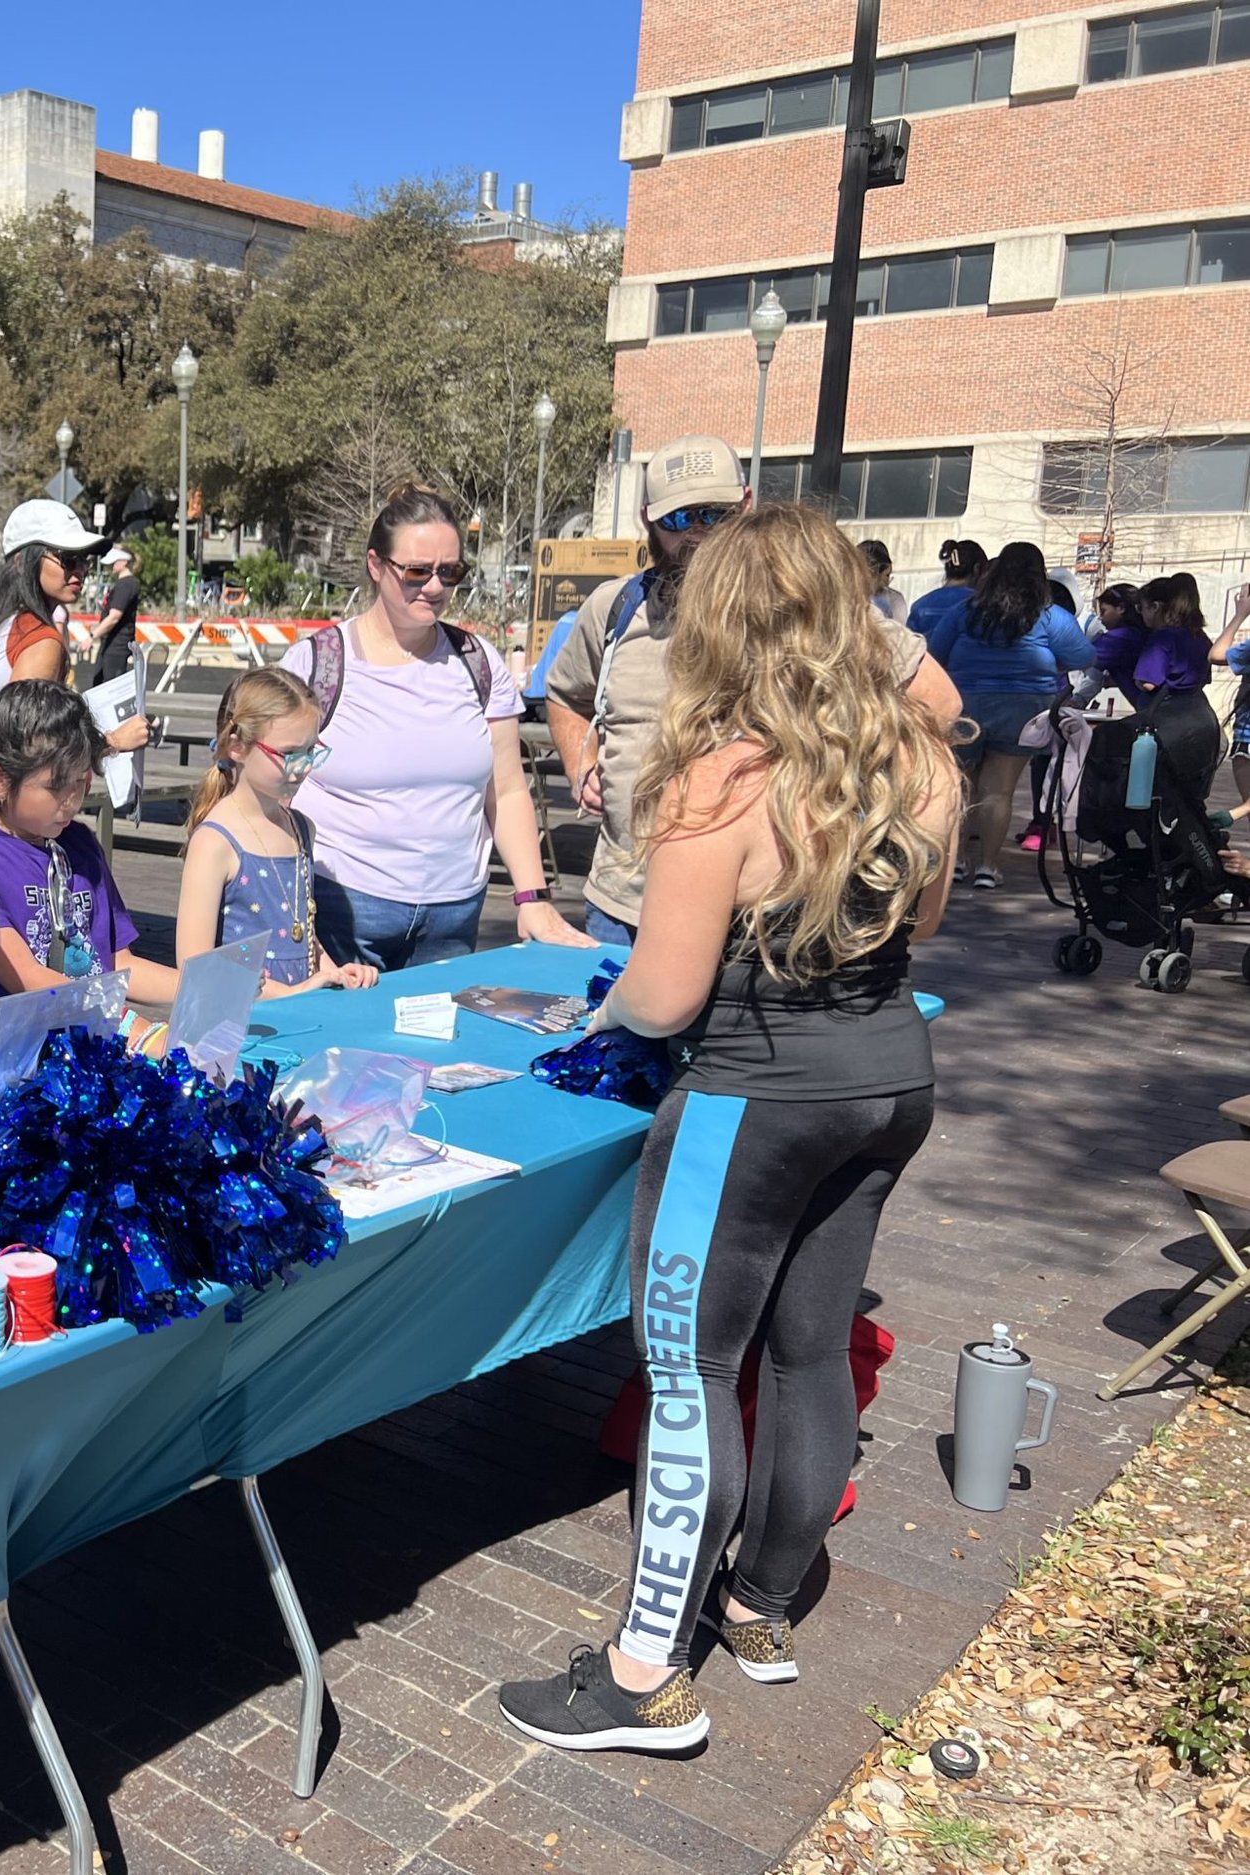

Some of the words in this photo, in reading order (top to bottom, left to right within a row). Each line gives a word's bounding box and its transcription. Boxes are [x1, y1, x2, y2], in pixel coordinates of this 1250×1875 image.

[24, 885, 93, 912] STRRS
[649, 1249, 702, 1432] CHEERS
[648, 1452, 705, 1537] SCI
[631, 1545, 691, 1639] THE
